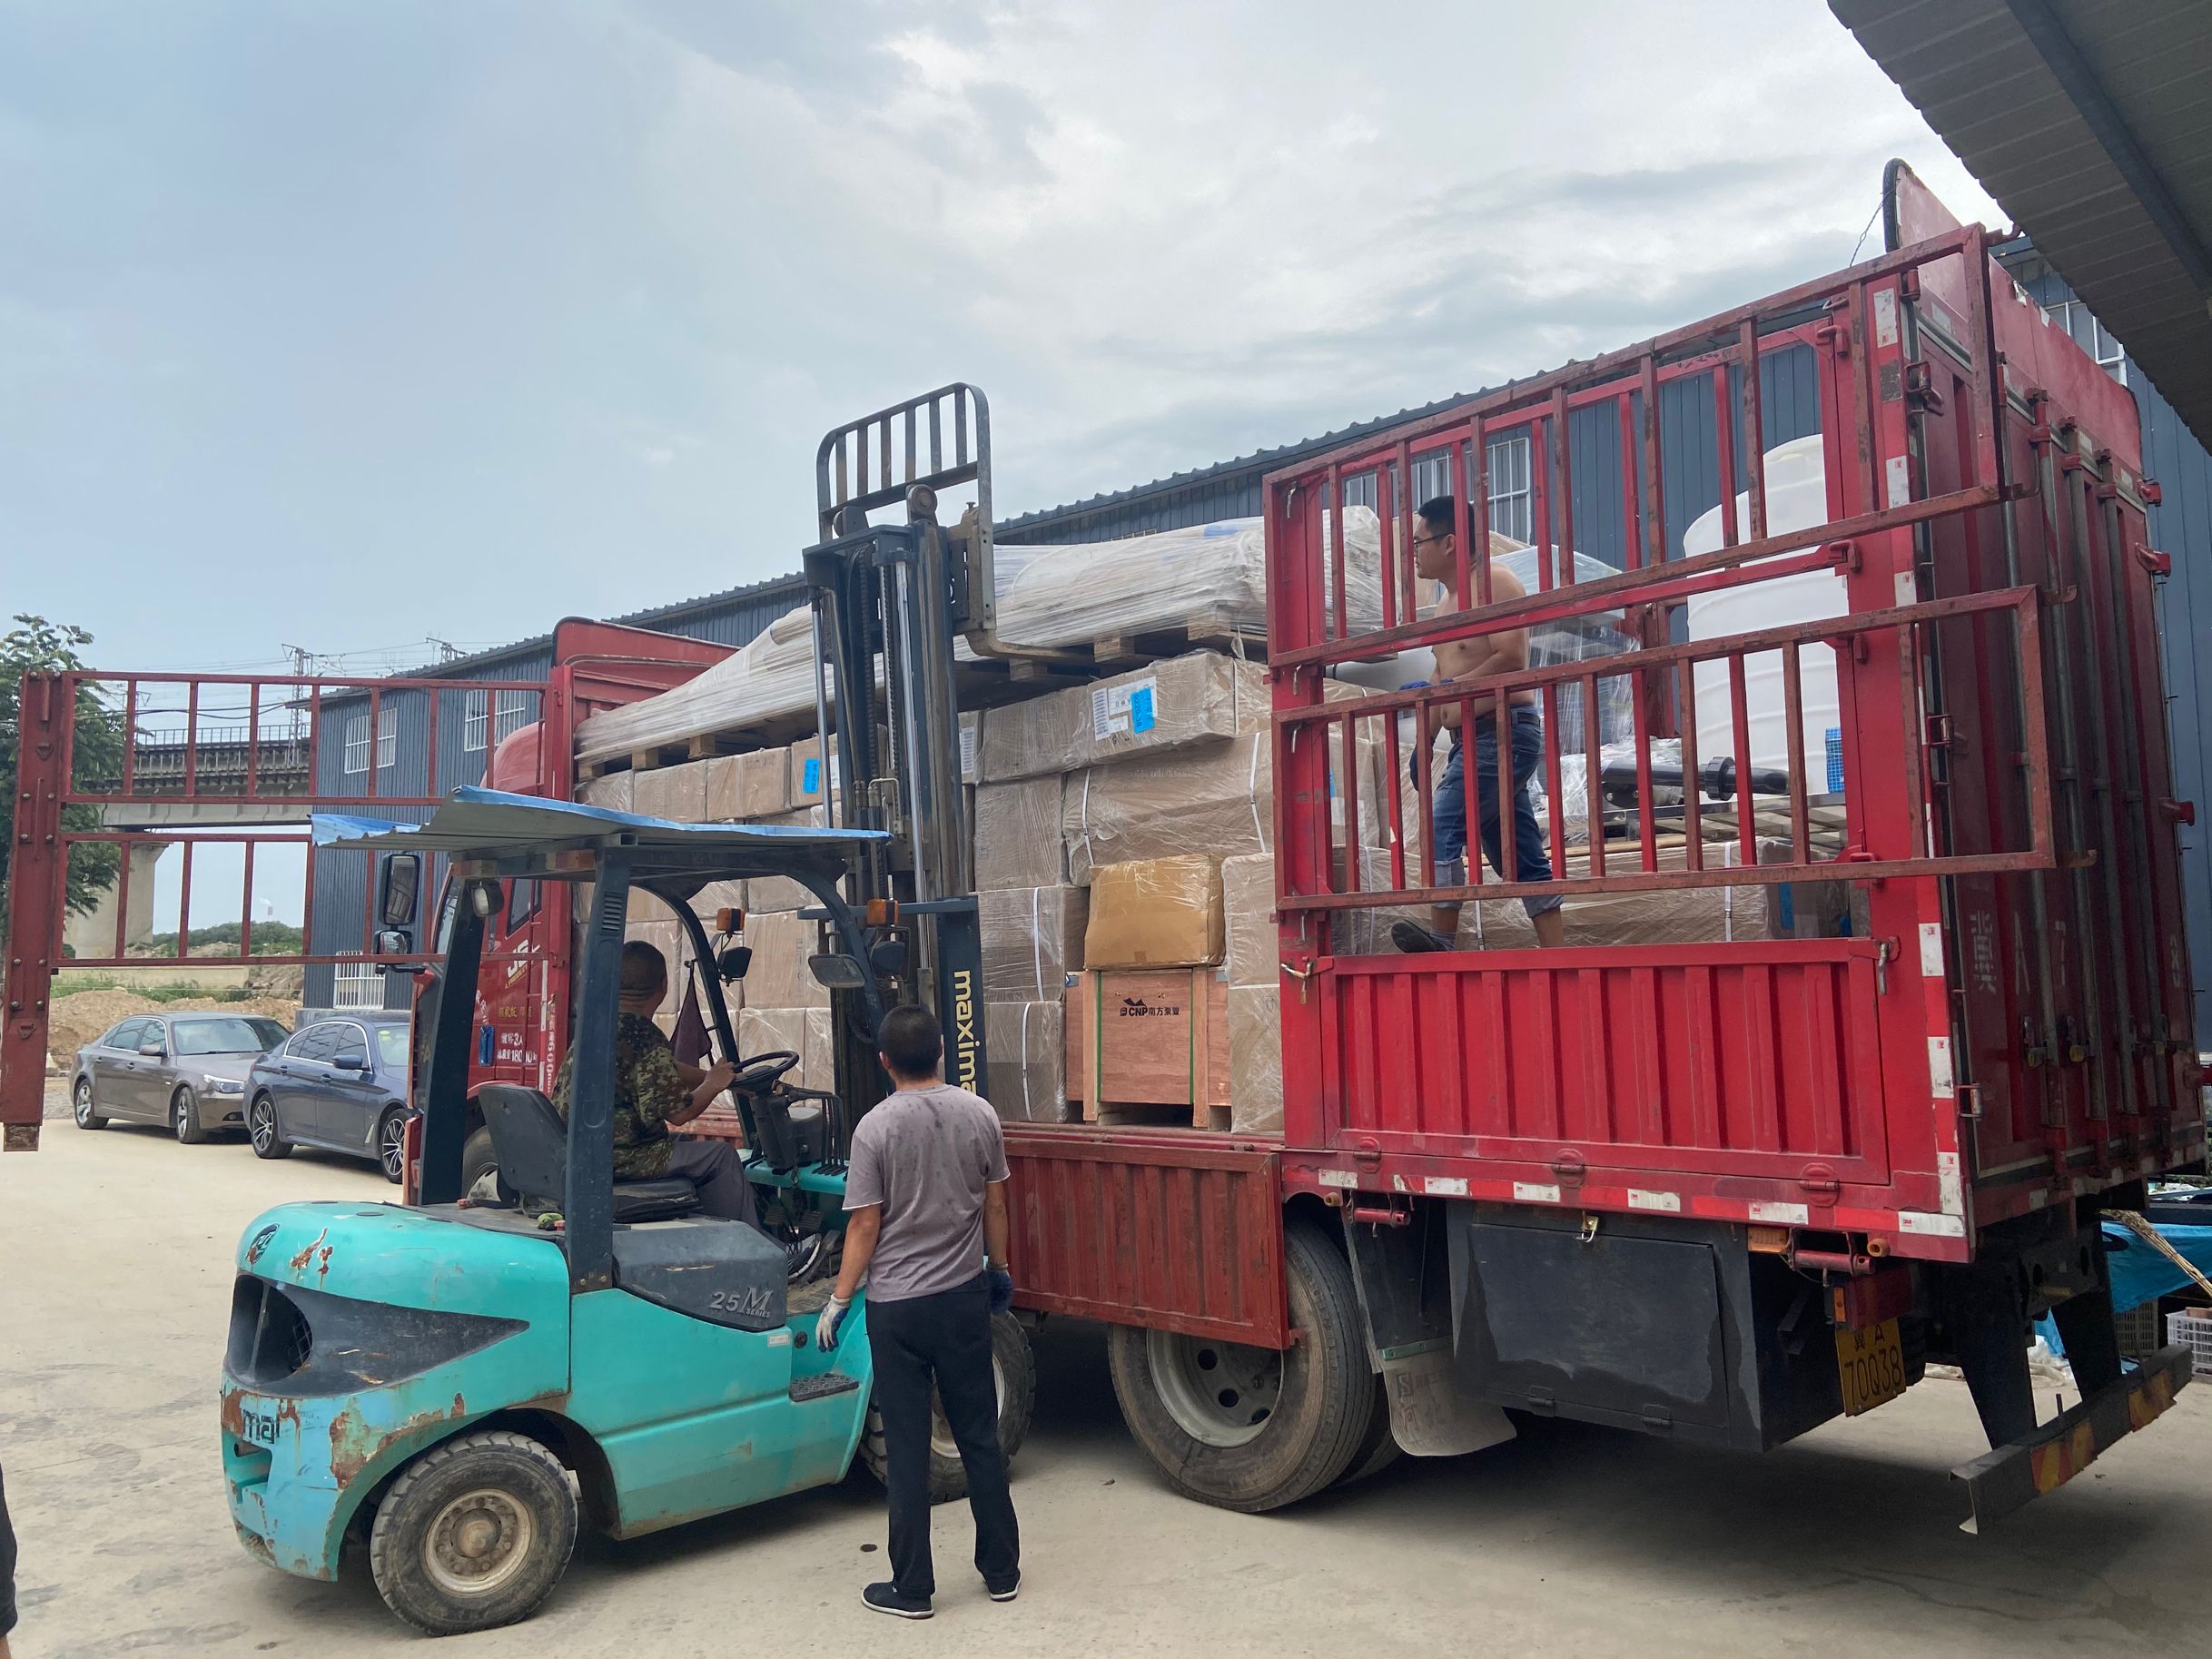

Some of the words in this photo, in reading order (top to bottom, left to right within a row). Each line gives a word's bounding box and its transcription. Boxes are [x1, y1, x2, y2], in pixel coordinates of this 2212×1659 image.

[1129, 1007, 1148, 1016] CNP
[746, 1308, 771, 1318] SERIES
[1844, 1347, 1901, 1407] 70Q38
